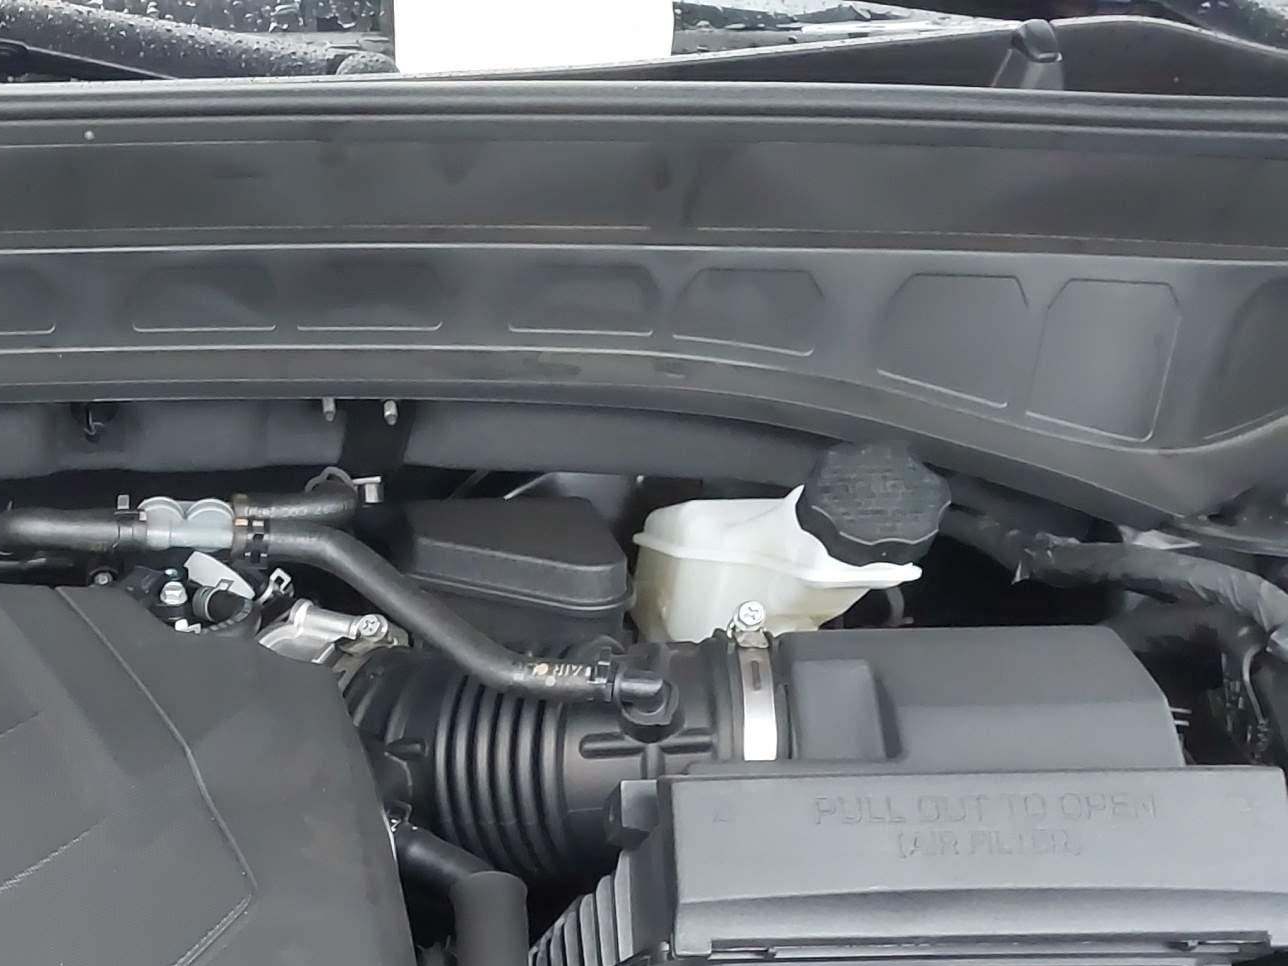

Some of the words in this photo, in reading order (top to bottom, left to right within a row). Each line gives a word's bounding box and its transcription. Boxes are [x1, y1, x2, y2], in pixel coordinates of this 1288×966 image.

[814, 795, 906, 825] PULL
[916, 793, 988, 823] OUT
[999, 793, 1049, 821] TO
[1059, 791, 1159, 820] OPEN
